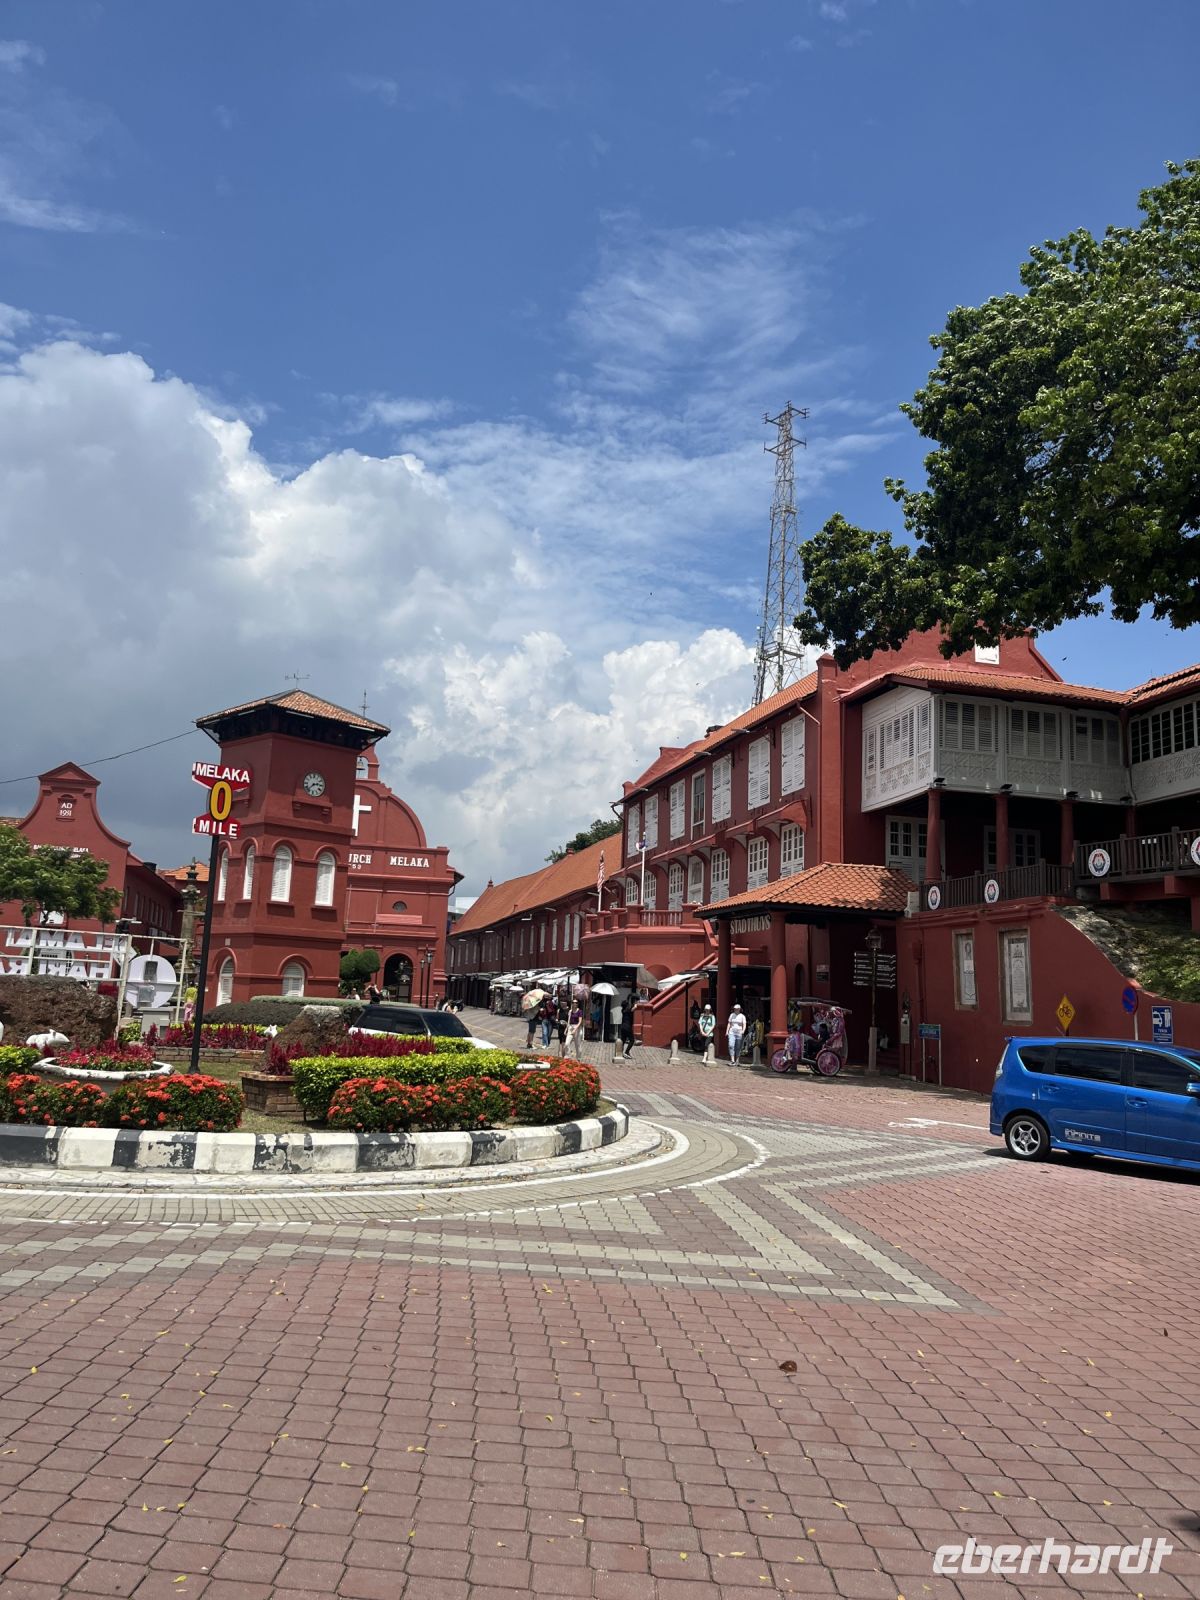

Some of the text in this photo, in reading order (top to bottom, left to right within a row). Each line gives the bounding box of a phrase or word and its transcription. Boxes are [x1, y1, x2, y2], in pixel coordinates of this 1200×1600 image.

[195, 762, 250, 783] MELAKA
[210, 780, 233, 820] 0
[198, 819, 238, 836] MILE
[390, 855, 430, 868] MELAKA
